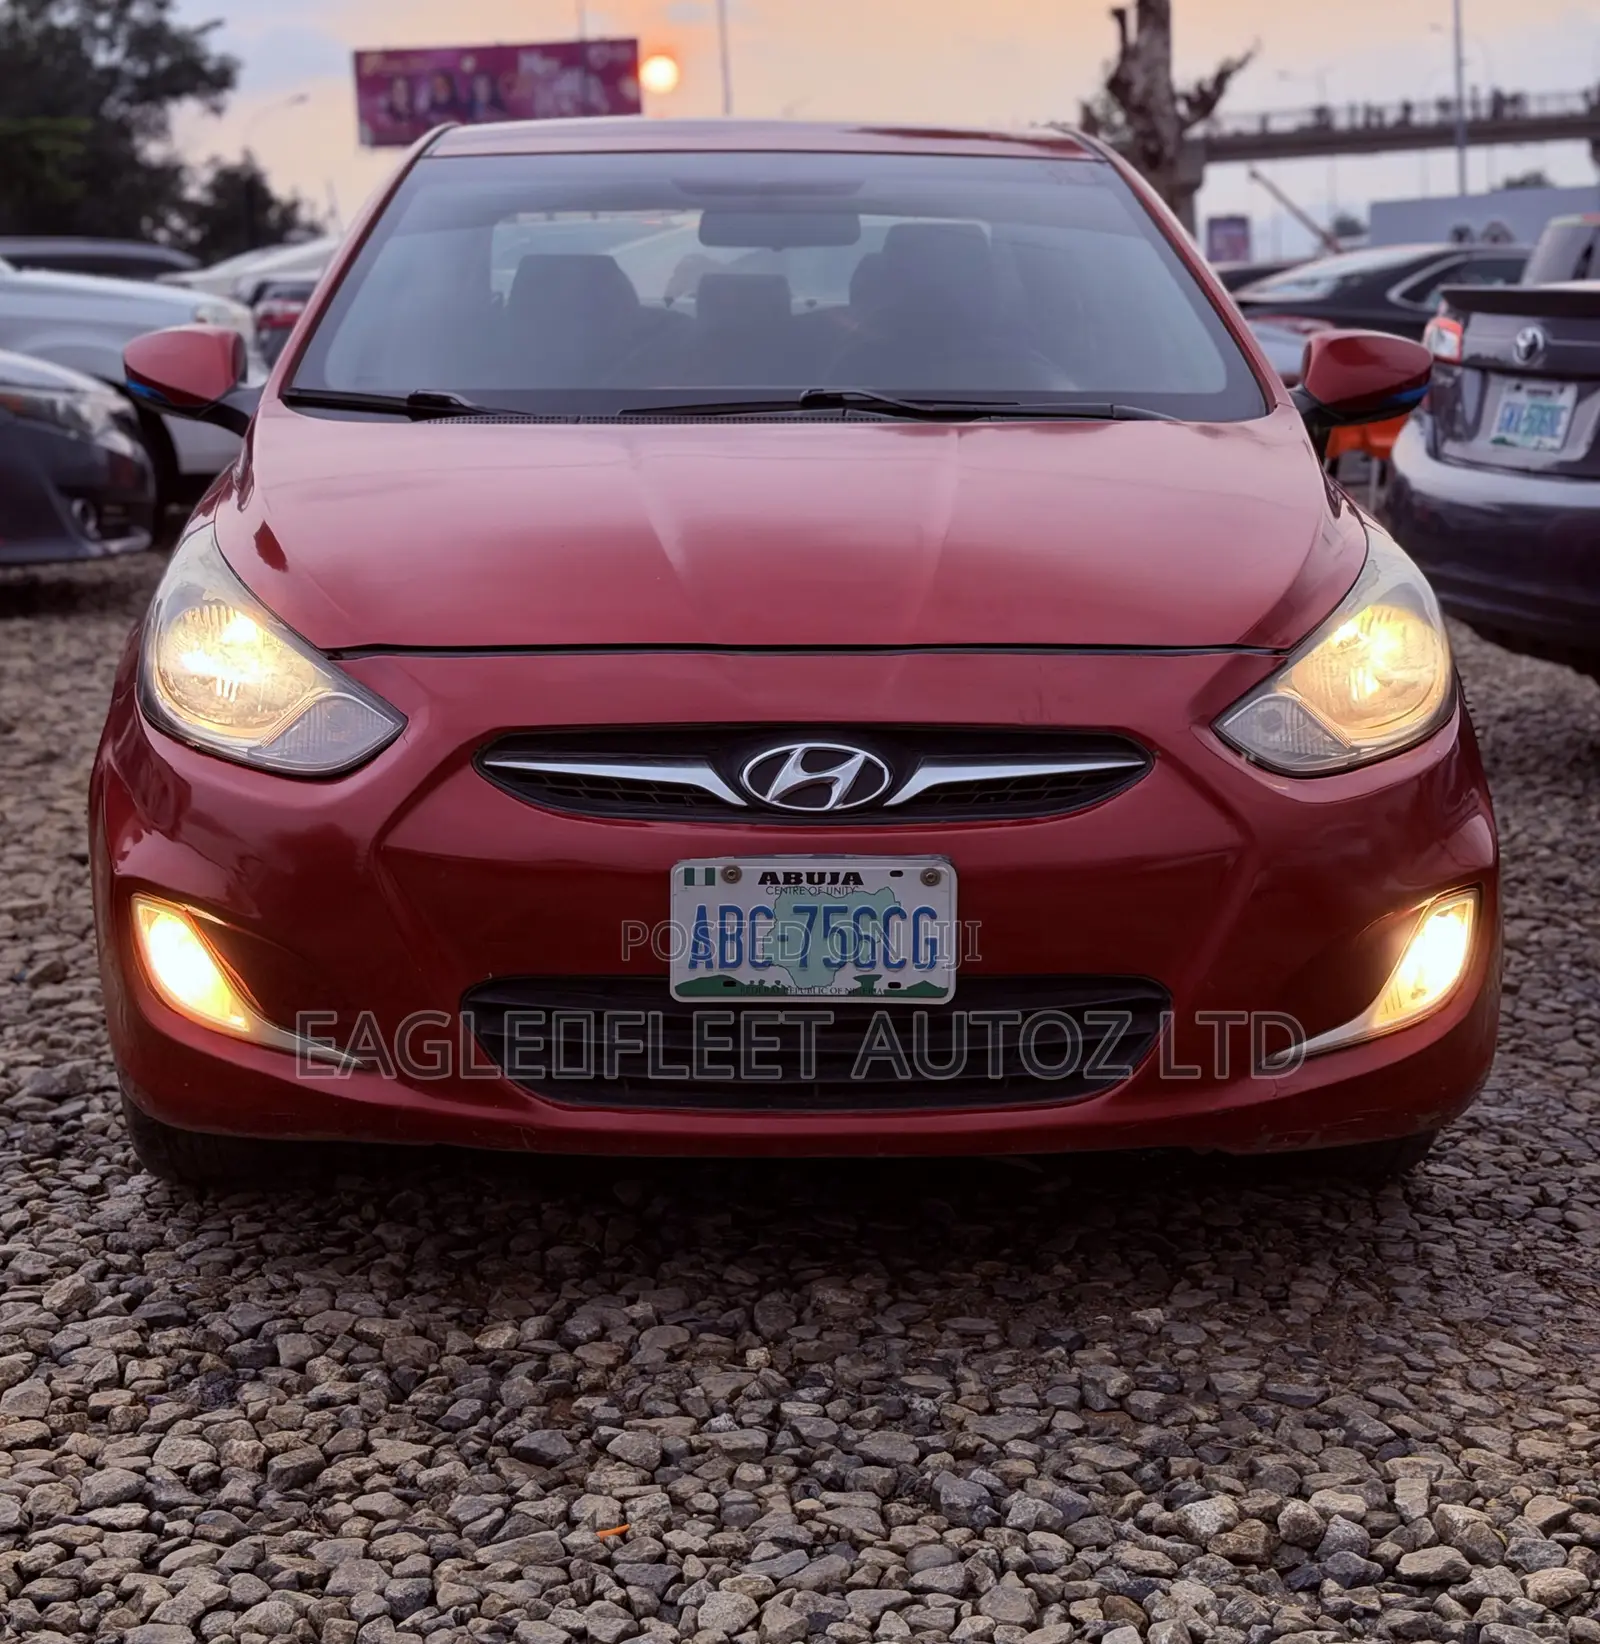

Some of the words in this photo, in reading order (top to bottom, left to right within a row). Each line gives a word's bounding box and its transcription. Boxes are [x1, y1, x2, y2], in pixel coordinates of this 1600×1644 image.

[758, 871, 864, 886] ABUJA
[765, 885, 807, 896] CENTRE
[808, 885, 824, 896] OF
[825, 885, 860, 896] UNITY
